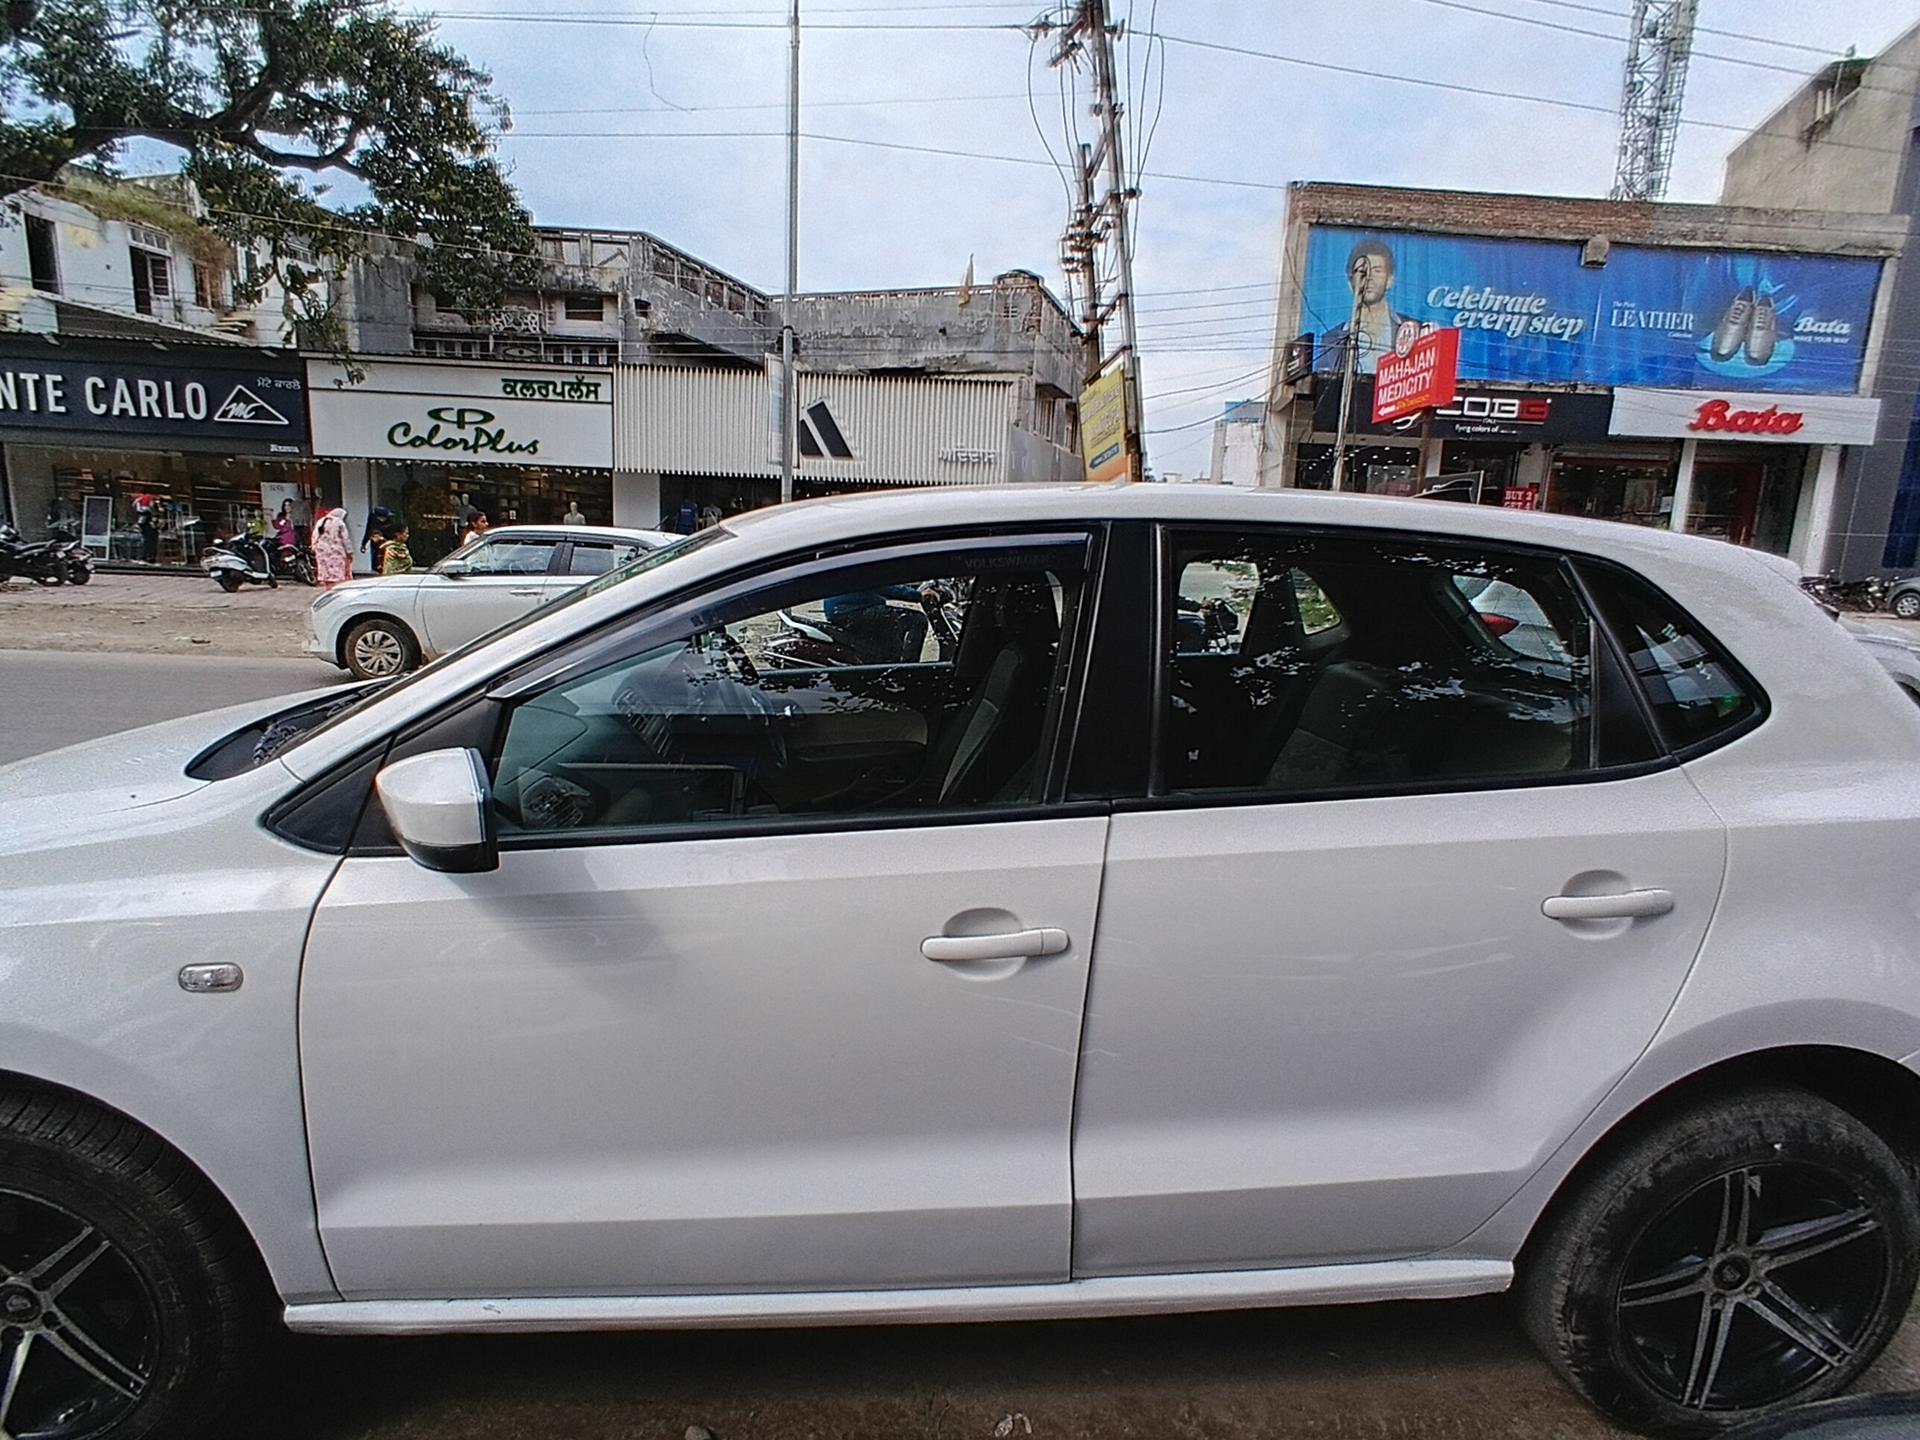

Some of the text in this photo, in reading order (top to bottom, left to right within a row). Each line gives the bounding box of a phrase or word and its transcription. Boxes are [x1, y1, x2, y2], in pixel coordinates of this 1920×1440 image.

[1427, 285, 1547, 315] Celebrate
[1452, 310, 1584, 341] every step
[1611, 309, 1694, 331] LEATHER
[1793, 316, 1851, 335] Bata
[1378, 346, 1436, 387] MAHAJAN
[85, 376, 207, 421] CARLO
[501, 375, 602, 401] ਕਲਰਪਲੱਸ
[1377, 368, 1434, 407] MEDICITY
[1688, 399, 1803, 434] Bata
[387, 421, 540, 455] ColorPlus
[1504, 490, 1524, 501] BUY
